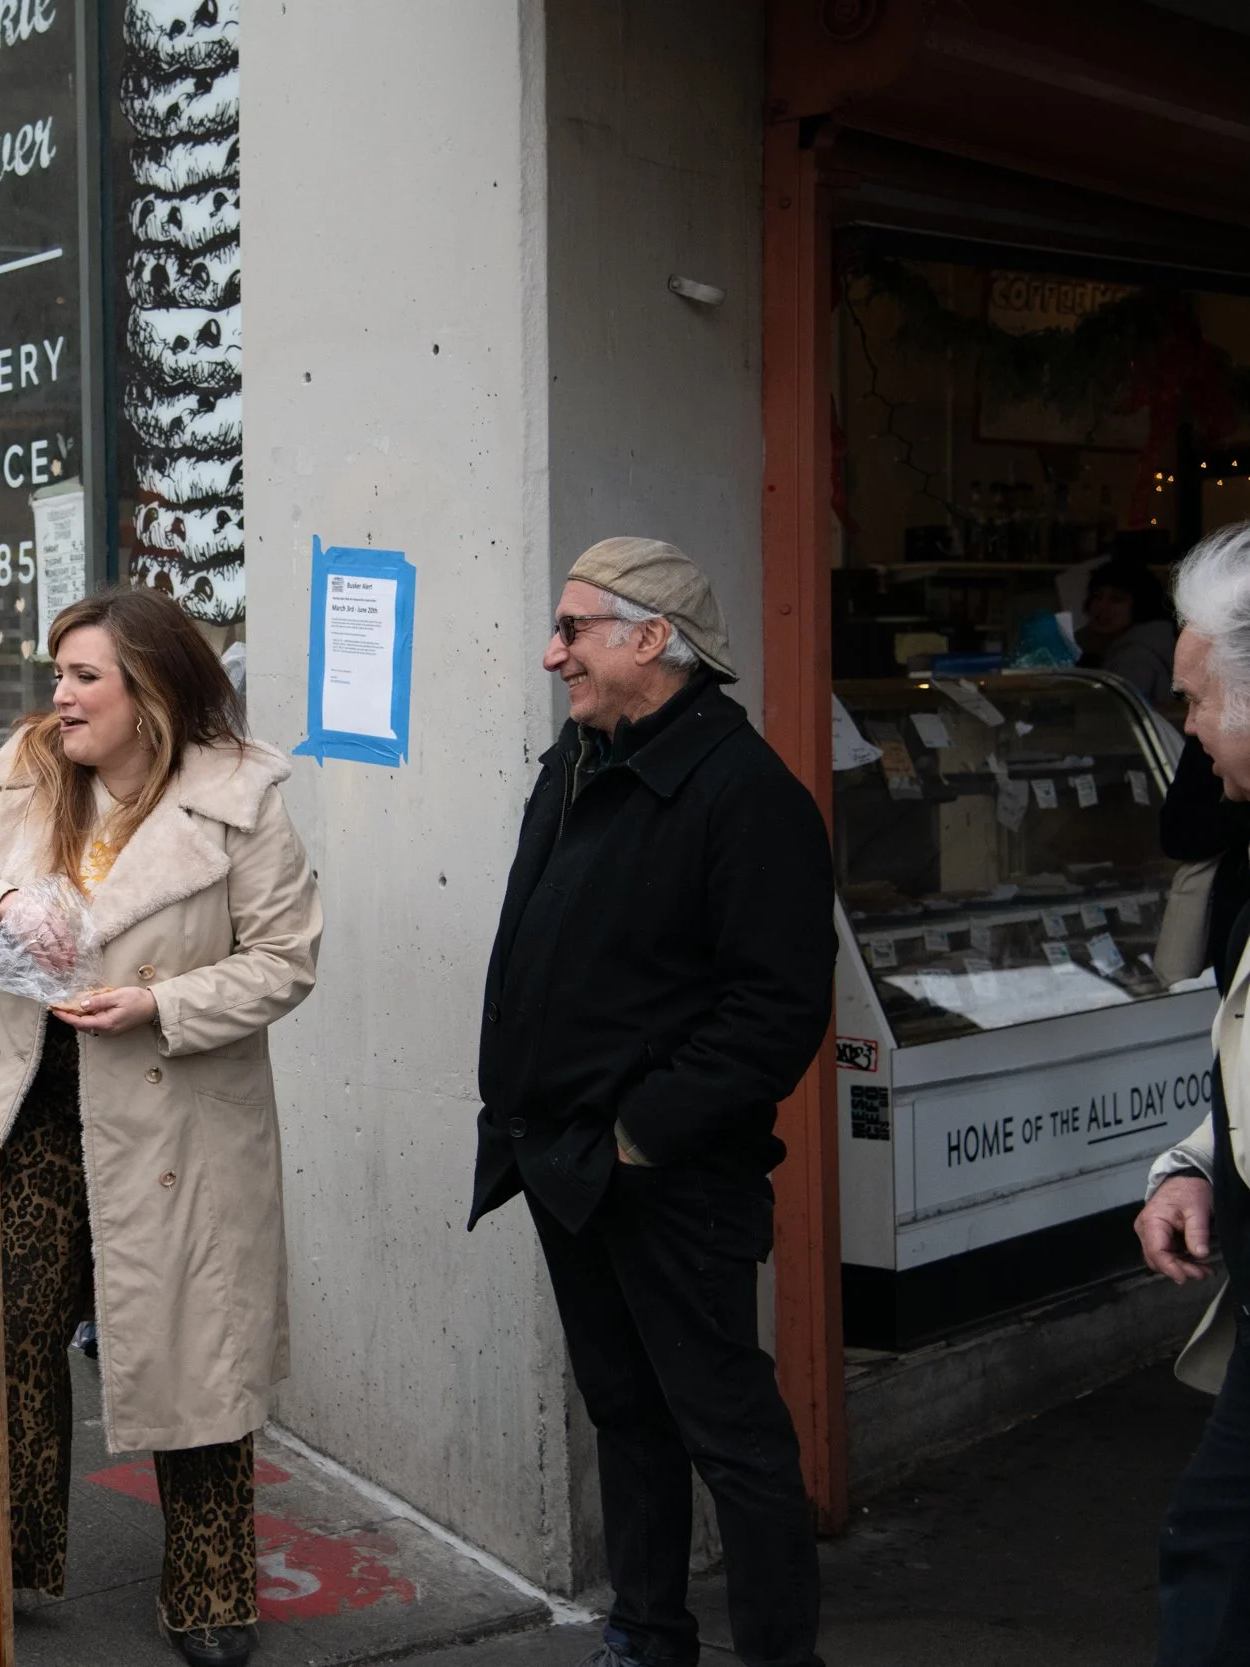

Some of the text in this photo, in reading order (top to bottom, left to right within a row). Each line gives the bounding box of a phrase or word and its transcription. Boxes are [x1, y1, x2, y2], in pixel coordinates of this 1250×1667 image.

[332, 604, 346, 612] March
[947, 1070, 1211, 1167] HOME OF THE ALL DAY COO
